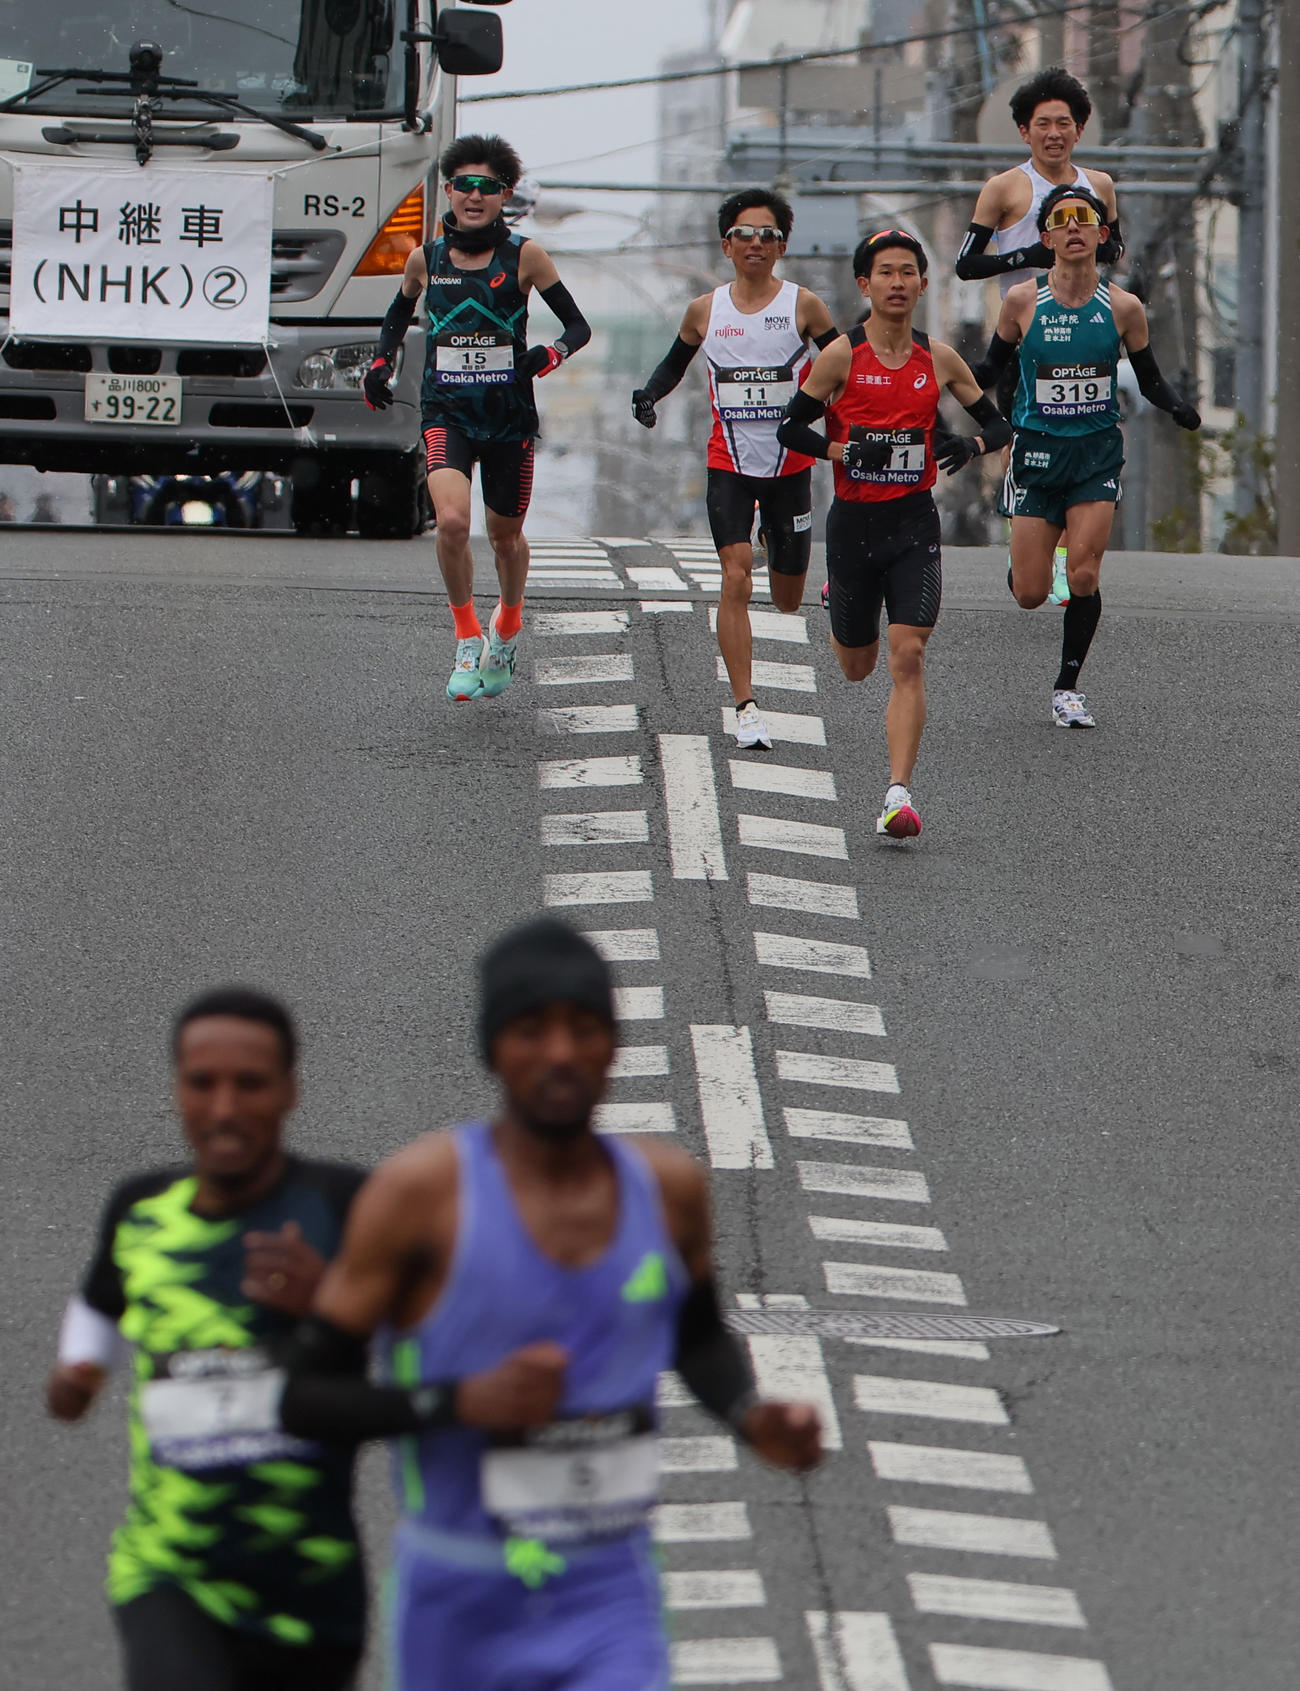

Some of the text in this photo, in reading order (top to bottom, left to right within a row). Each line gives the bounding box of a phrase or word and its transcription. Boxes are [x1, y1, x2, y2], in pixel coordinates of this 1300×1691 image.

[304, 194, 365, 217] RS-2
[58, 200, 224, 248] 中継車
[764, 316, 791, 324] MOVE
[1039, 313, 1080, 326] 青山学院
[715, 326, 745, 338] FUJITSU
[764, 323, 791, 331] SPORT
[450, 335, 497, 347] OPTAGE
[462, 352, 487, 365] 15
[441, 372, 508, 384] Osaka Metro
[733, 370, 778, 382] OPTAGE
[1052, 366, 1097, 378] OPTAGE
[856, 374, 892, 385] 三菱重工
[743, 387, 766, 400] 11
[1050, 383, 1099, 403] 319
[106, 394, 176, 422] 99-22
[724, 408, 756, 420] Osaka
[1042, 403, 1106, 416] Osaka Metro
[866, 431, 912, 444] OPTAGE
[850, 469, 919, 483] Osaka Metro
